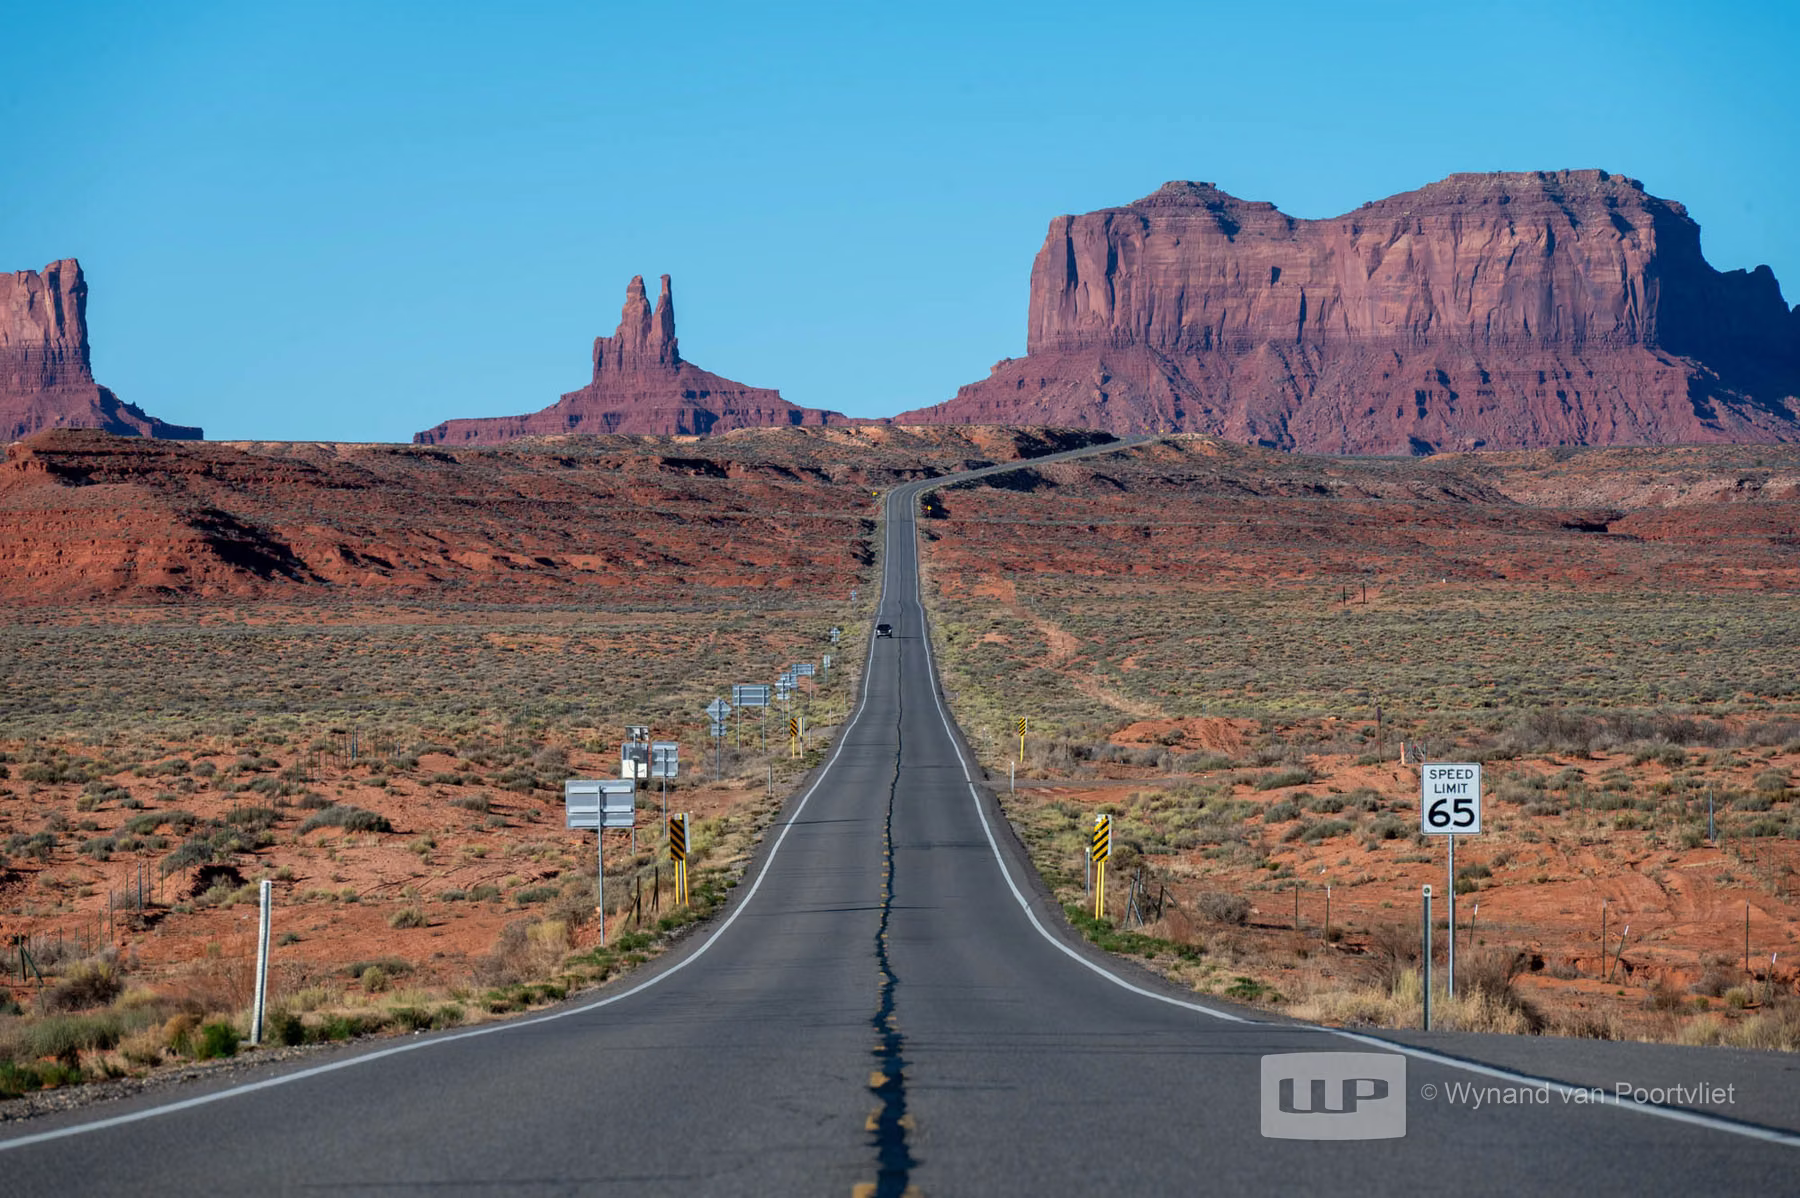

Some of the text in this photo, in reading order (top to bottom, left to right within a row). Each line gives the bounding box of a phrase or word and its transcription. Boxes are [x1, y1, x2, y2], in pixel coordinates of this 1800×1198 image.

[1429, 769, 1473, 779] SPEED
[1434, 783, 1468, 794] LIMIT
[1428, 798, 1475, 827] 65
